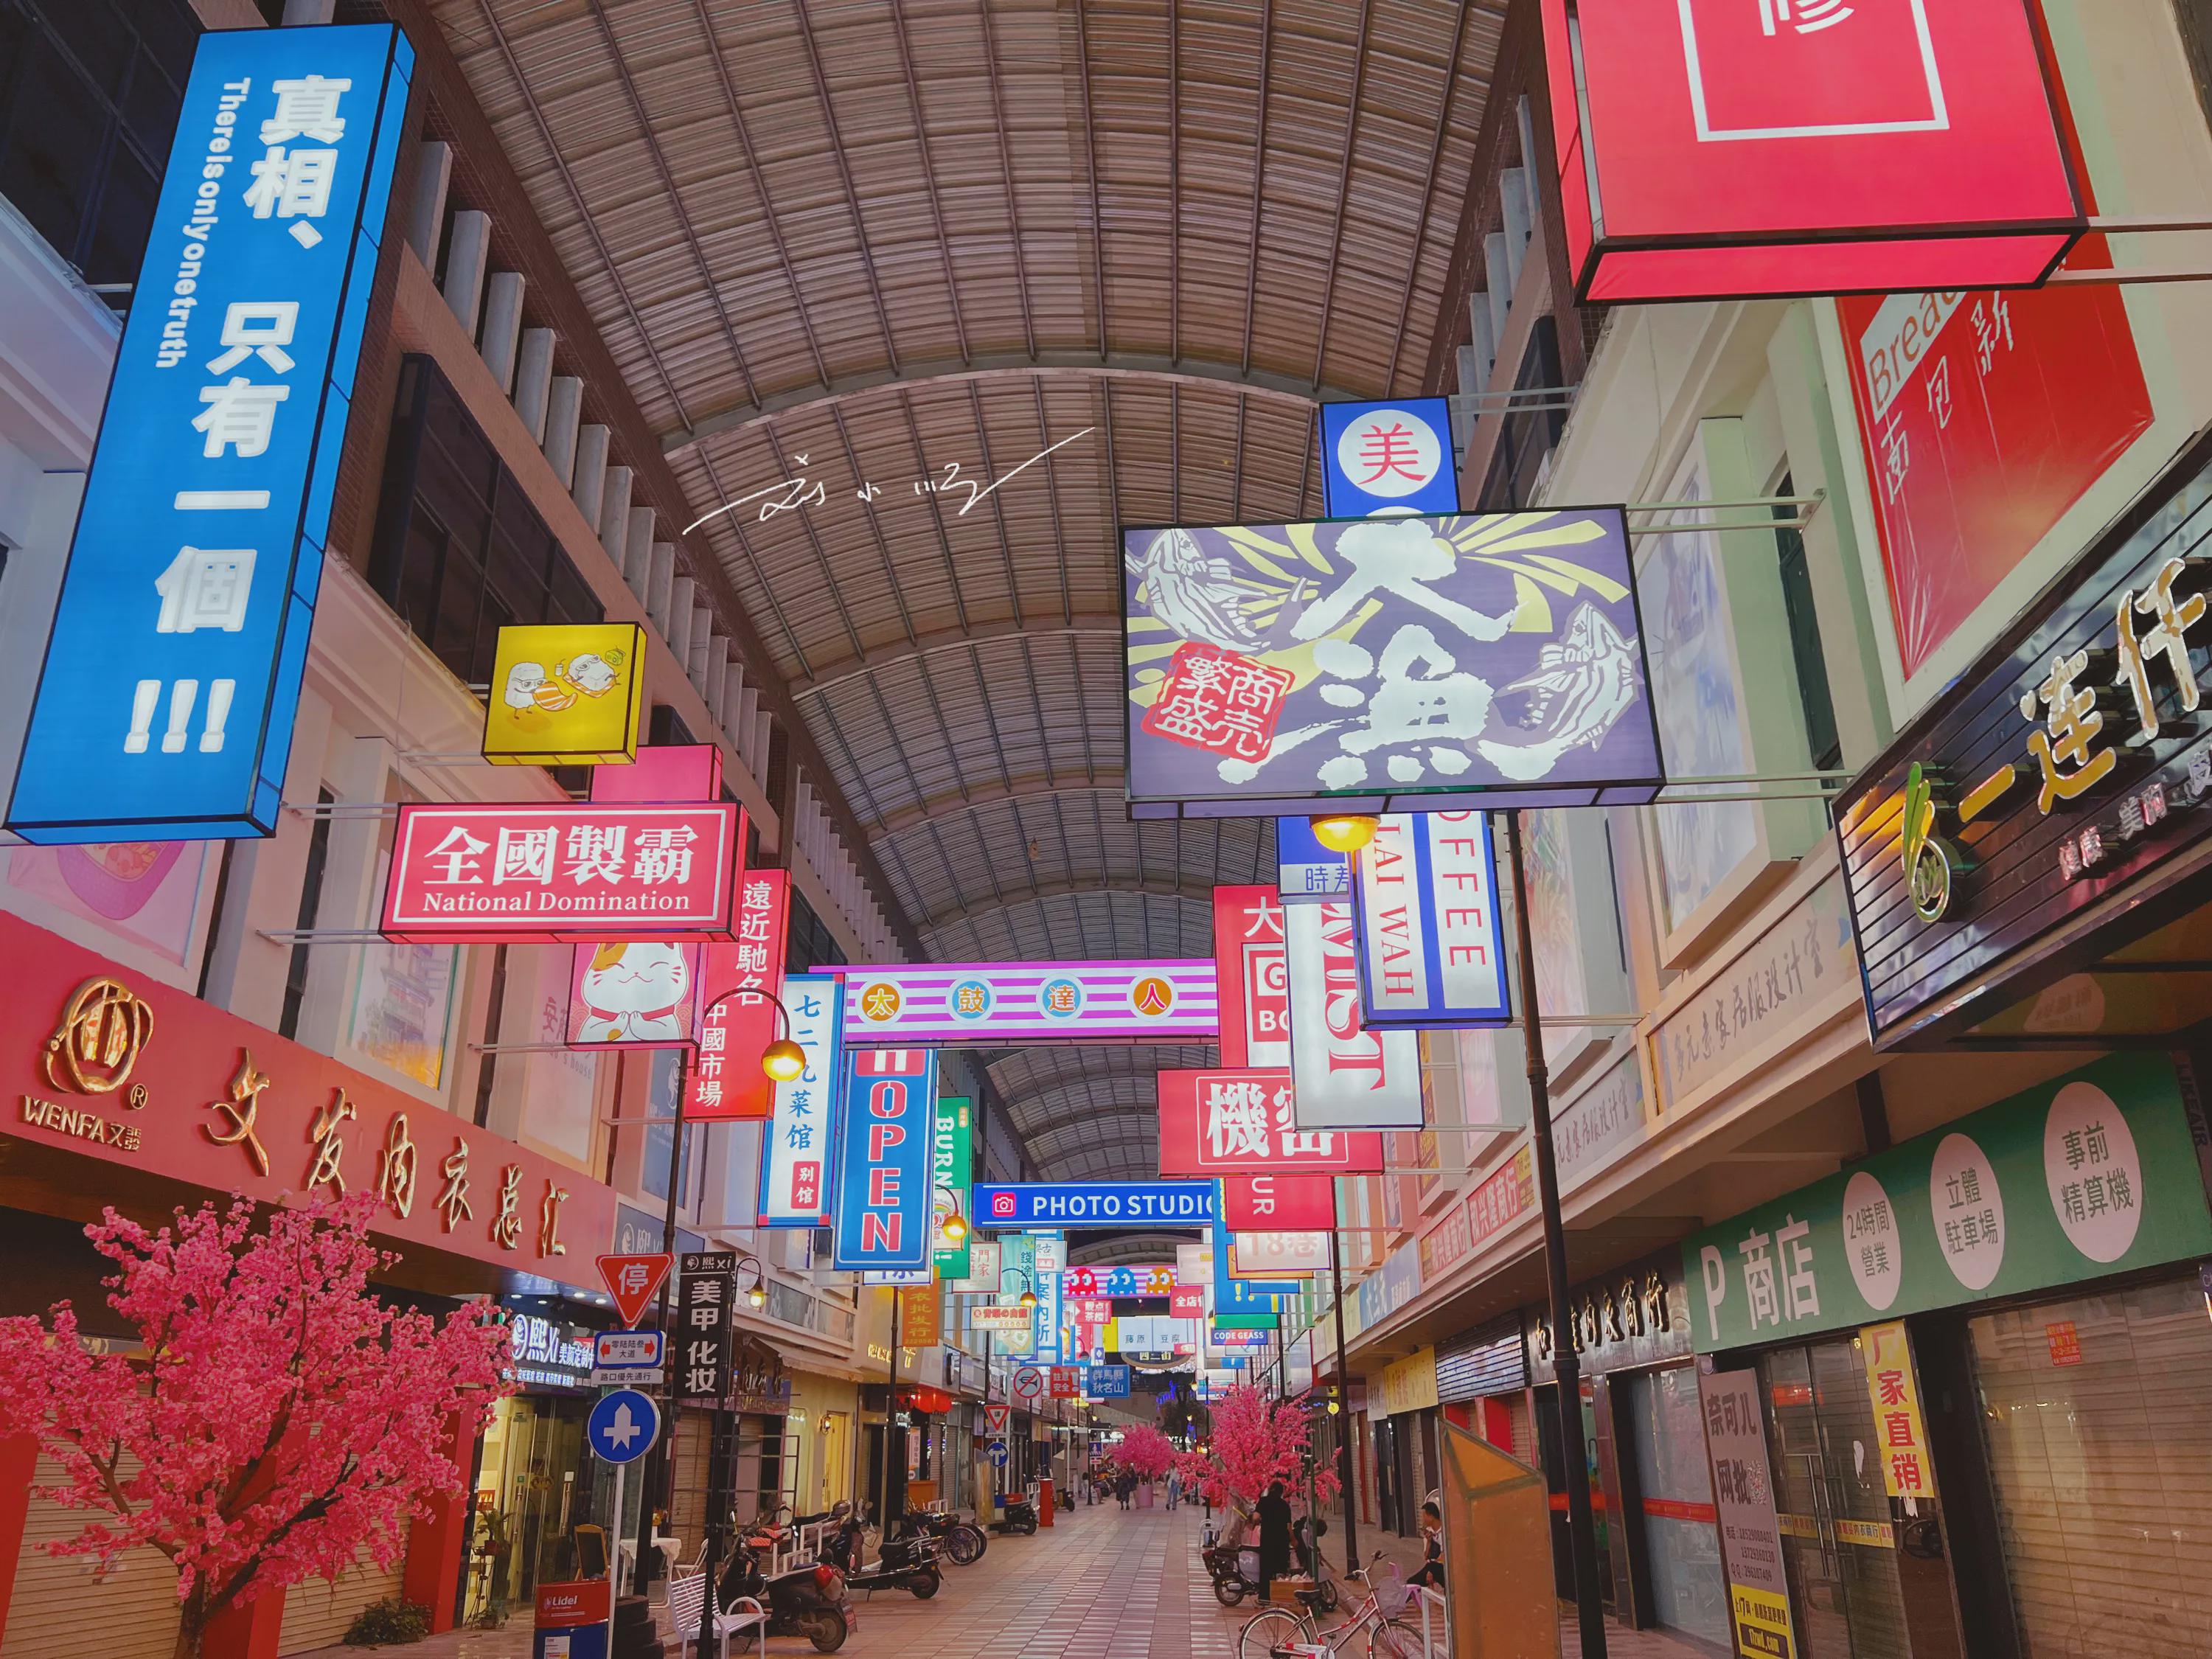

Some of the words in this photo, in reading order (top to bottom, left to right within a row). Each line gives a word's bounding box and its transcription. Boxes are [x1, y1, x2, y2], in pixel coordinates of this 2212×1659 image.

[1358, 422, 1427, 484] 美
[423, 825, 698, 886] 全國製霸
[422, 891, 531, 912] National
[538, 890, 690, 911] Domination
[734, 880, 773, 1006] 遠近馳名
[1380, 903, 1414, 997] WAH
[697, 1004, 728, 1107] 中國市場
[860, 1080, 908, 1253] OPEN
[2062, 1121, 2110, 1172] 事前
[1033, 1195, 1121, 1217] PHOTO
[1945, 1167, 1982, 1210] 立體
[2062, 1169, 2135, 1224] 精算機
[618, 1263, 650, 1296] 停
[1739, 1213, 1820, 1331] 商店
[1860, 1241, 1891, 1279] 營業
[619, 1349, 636, 1359] 大道
[1214, 1331, 1237, 1340] CODE
[1237, 1330, 1265, 1340] GEASS
[1870, 1329, 1923, 1492] 厂家直销
